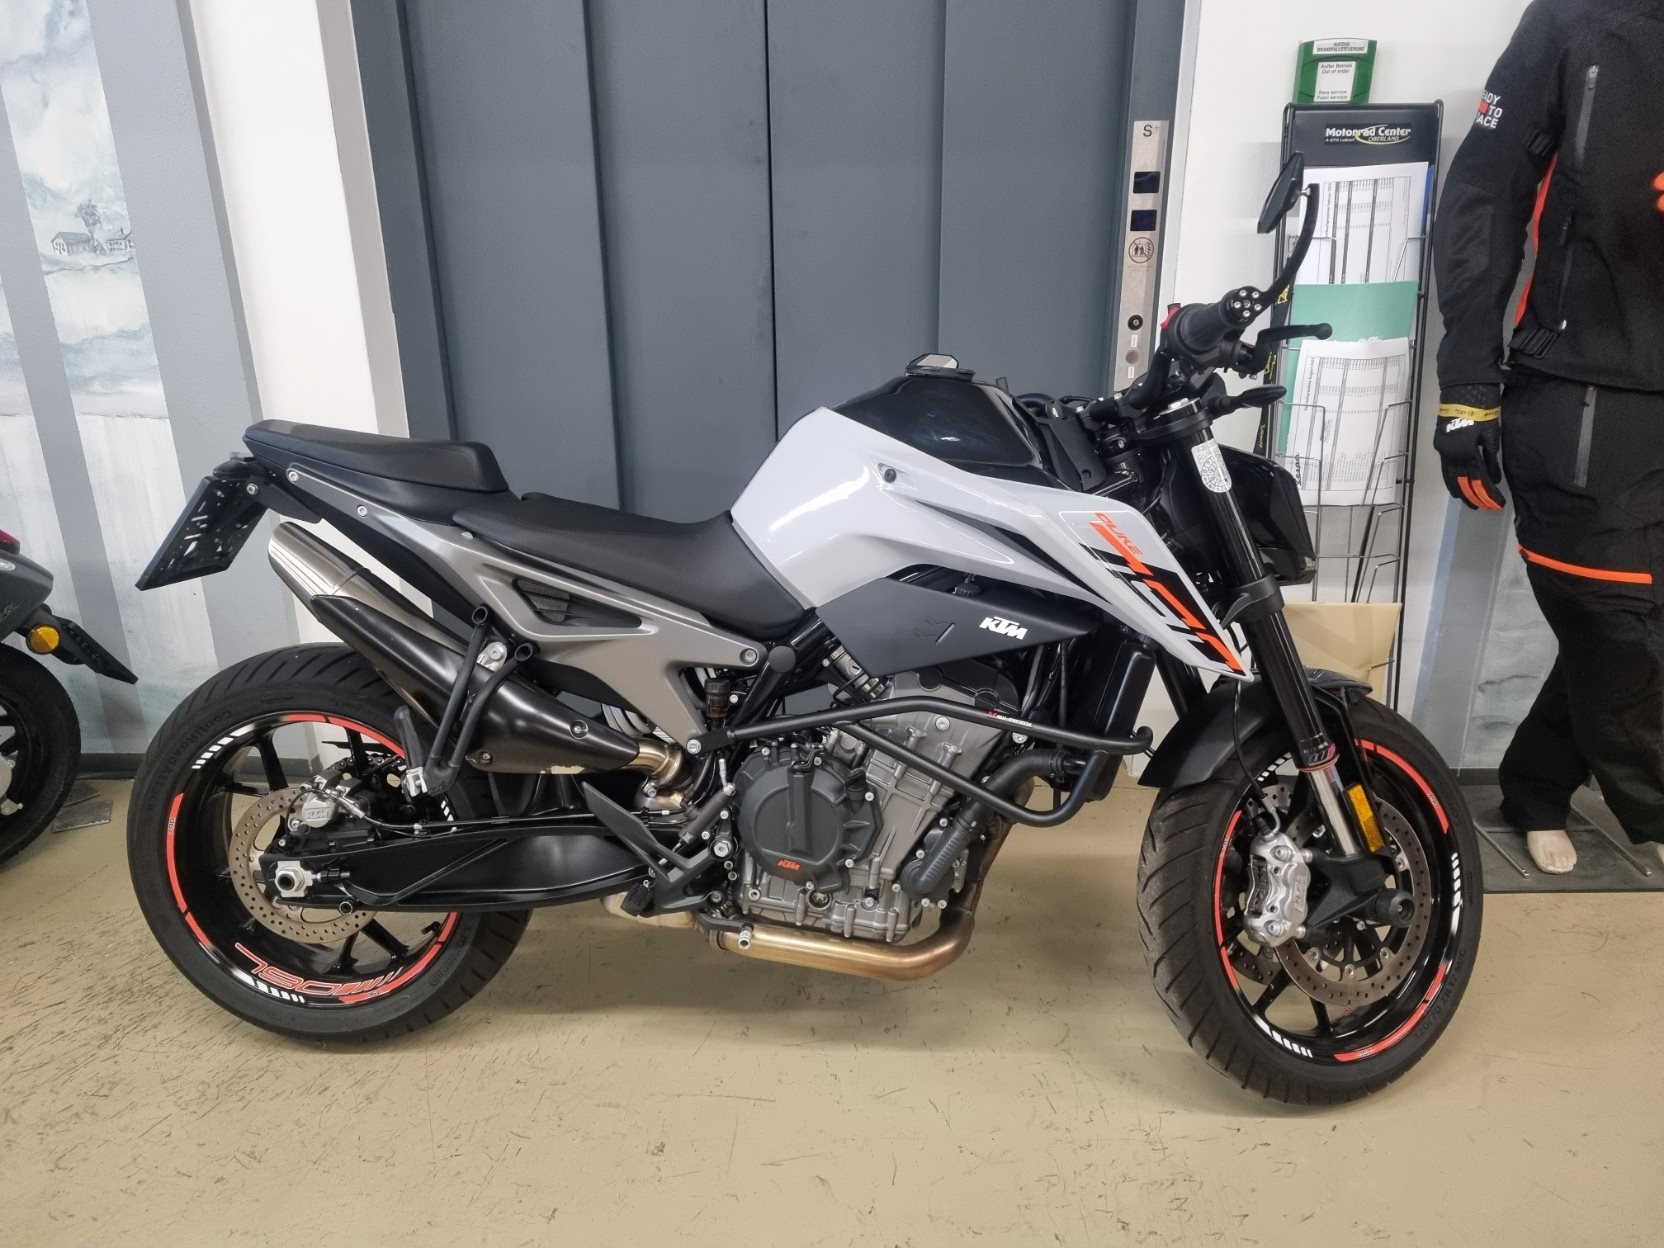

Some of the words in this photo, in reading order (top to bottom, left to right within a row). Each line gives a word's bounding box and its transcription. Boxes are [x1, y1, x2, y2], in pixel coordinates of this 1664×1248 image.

[1488, 104, 1503, 118] TO
[1325, 127, 1376, 137] Motorrad
[1377, 126, 1412, 137] Center
[1094, 511, 1144, 556] DUKE
[979, 615, 1028, 640] KTM
[777, 859, 801, 871] KTM
